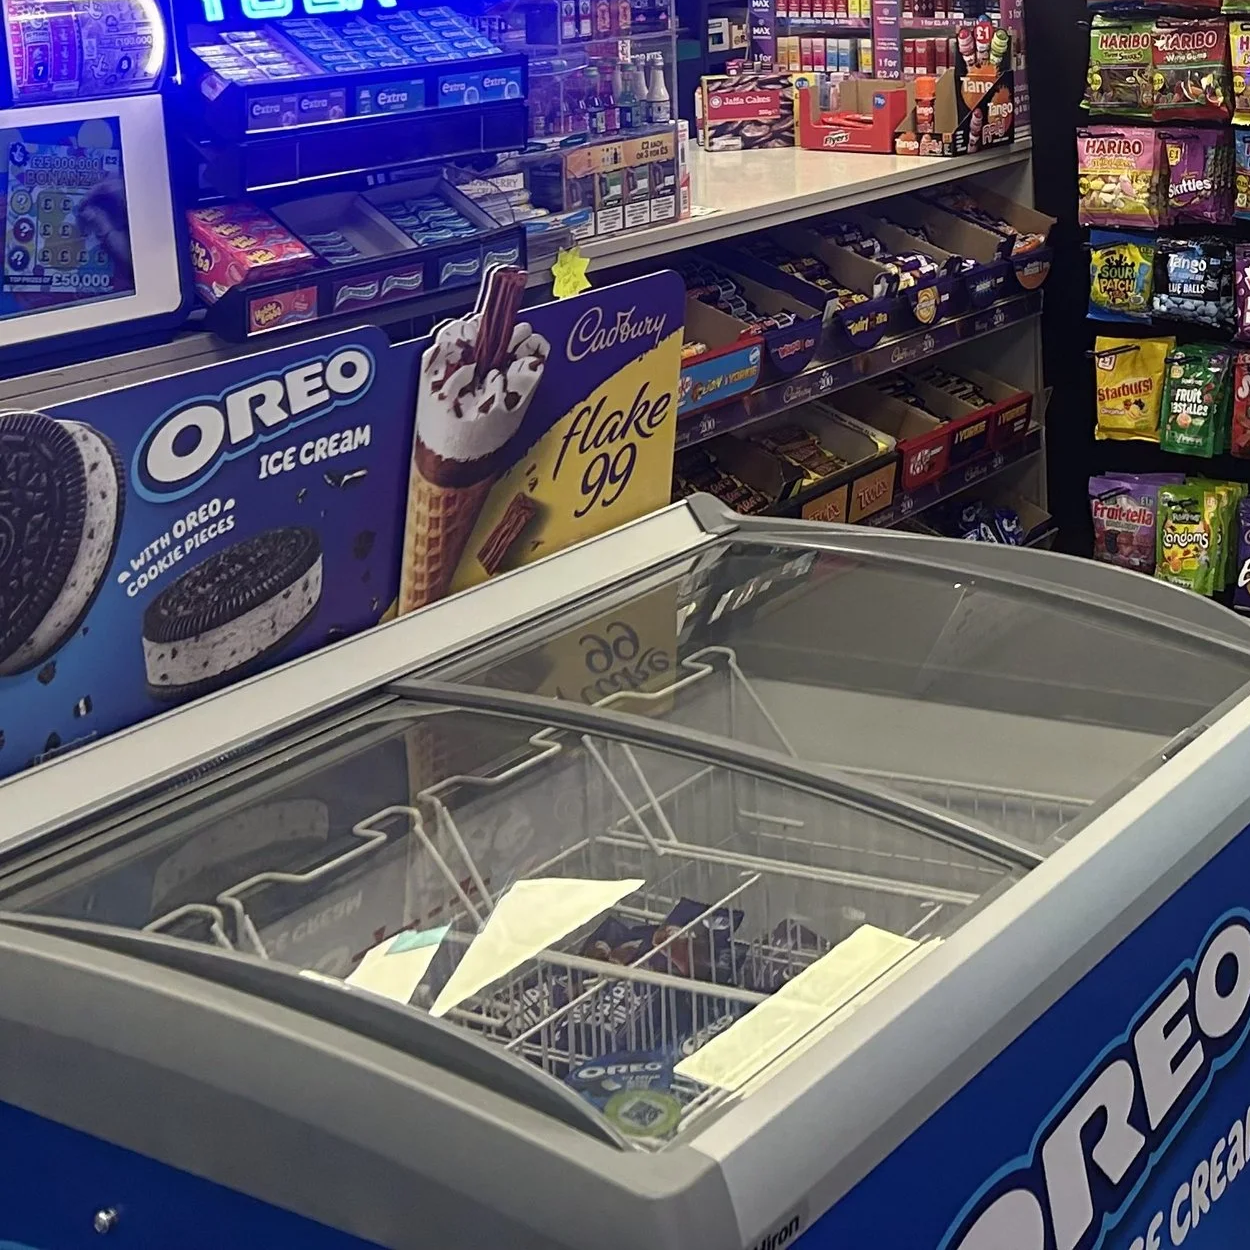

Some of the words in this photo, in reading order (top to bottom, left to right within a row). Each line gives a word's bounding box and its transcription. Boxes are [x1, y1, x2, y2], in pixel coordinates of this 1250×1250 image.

[976, 27, 989, 40] £1
[1099, 33, 1149, 50] HARIBO
[1157, 31, 1217, 50] HARIBO
[884, 58, 897, 67] for
[723, 97, 744, 105] Jaffa
[745, 95, 771, 104] Cakes
[987, 102, 1013, 117] Tango
[823, 132, 849, 146] Flyers
[895, 138, 919, 149] Tango
[1085, 139, 1143, 157] HARIBO
[1169, 178, 1211, 198] Skittles
[1101, 266, 1134, 279] SOUR
[1168, 253, 1206, 273] Tango
[51, 273, 110, 288] £50,000
[1100, 278, 1134, 291] PATCH
[566, 307, 667, 362] Cadbury
[1098, 378, 1153, 402] Starburst
[146, 349, 370, 483] OREO
[553, 382, 671, 480] flake
[258, 449, 296, 480] ICE
[299, 424, 371, 467] CREAM
[574, 443, 637, 518] 99
[859, 478, 888, 510] Twix
[1094, 501, 1153, 526] Fruit-tella
[129, 536, 170, 571] WITH
[172, 498, 221, 538] OREO
[127, 553, 183, 598] COOKIE
[185, 515, 235, 556] PIECES
[578, 1062, 662, 1079] OREO
